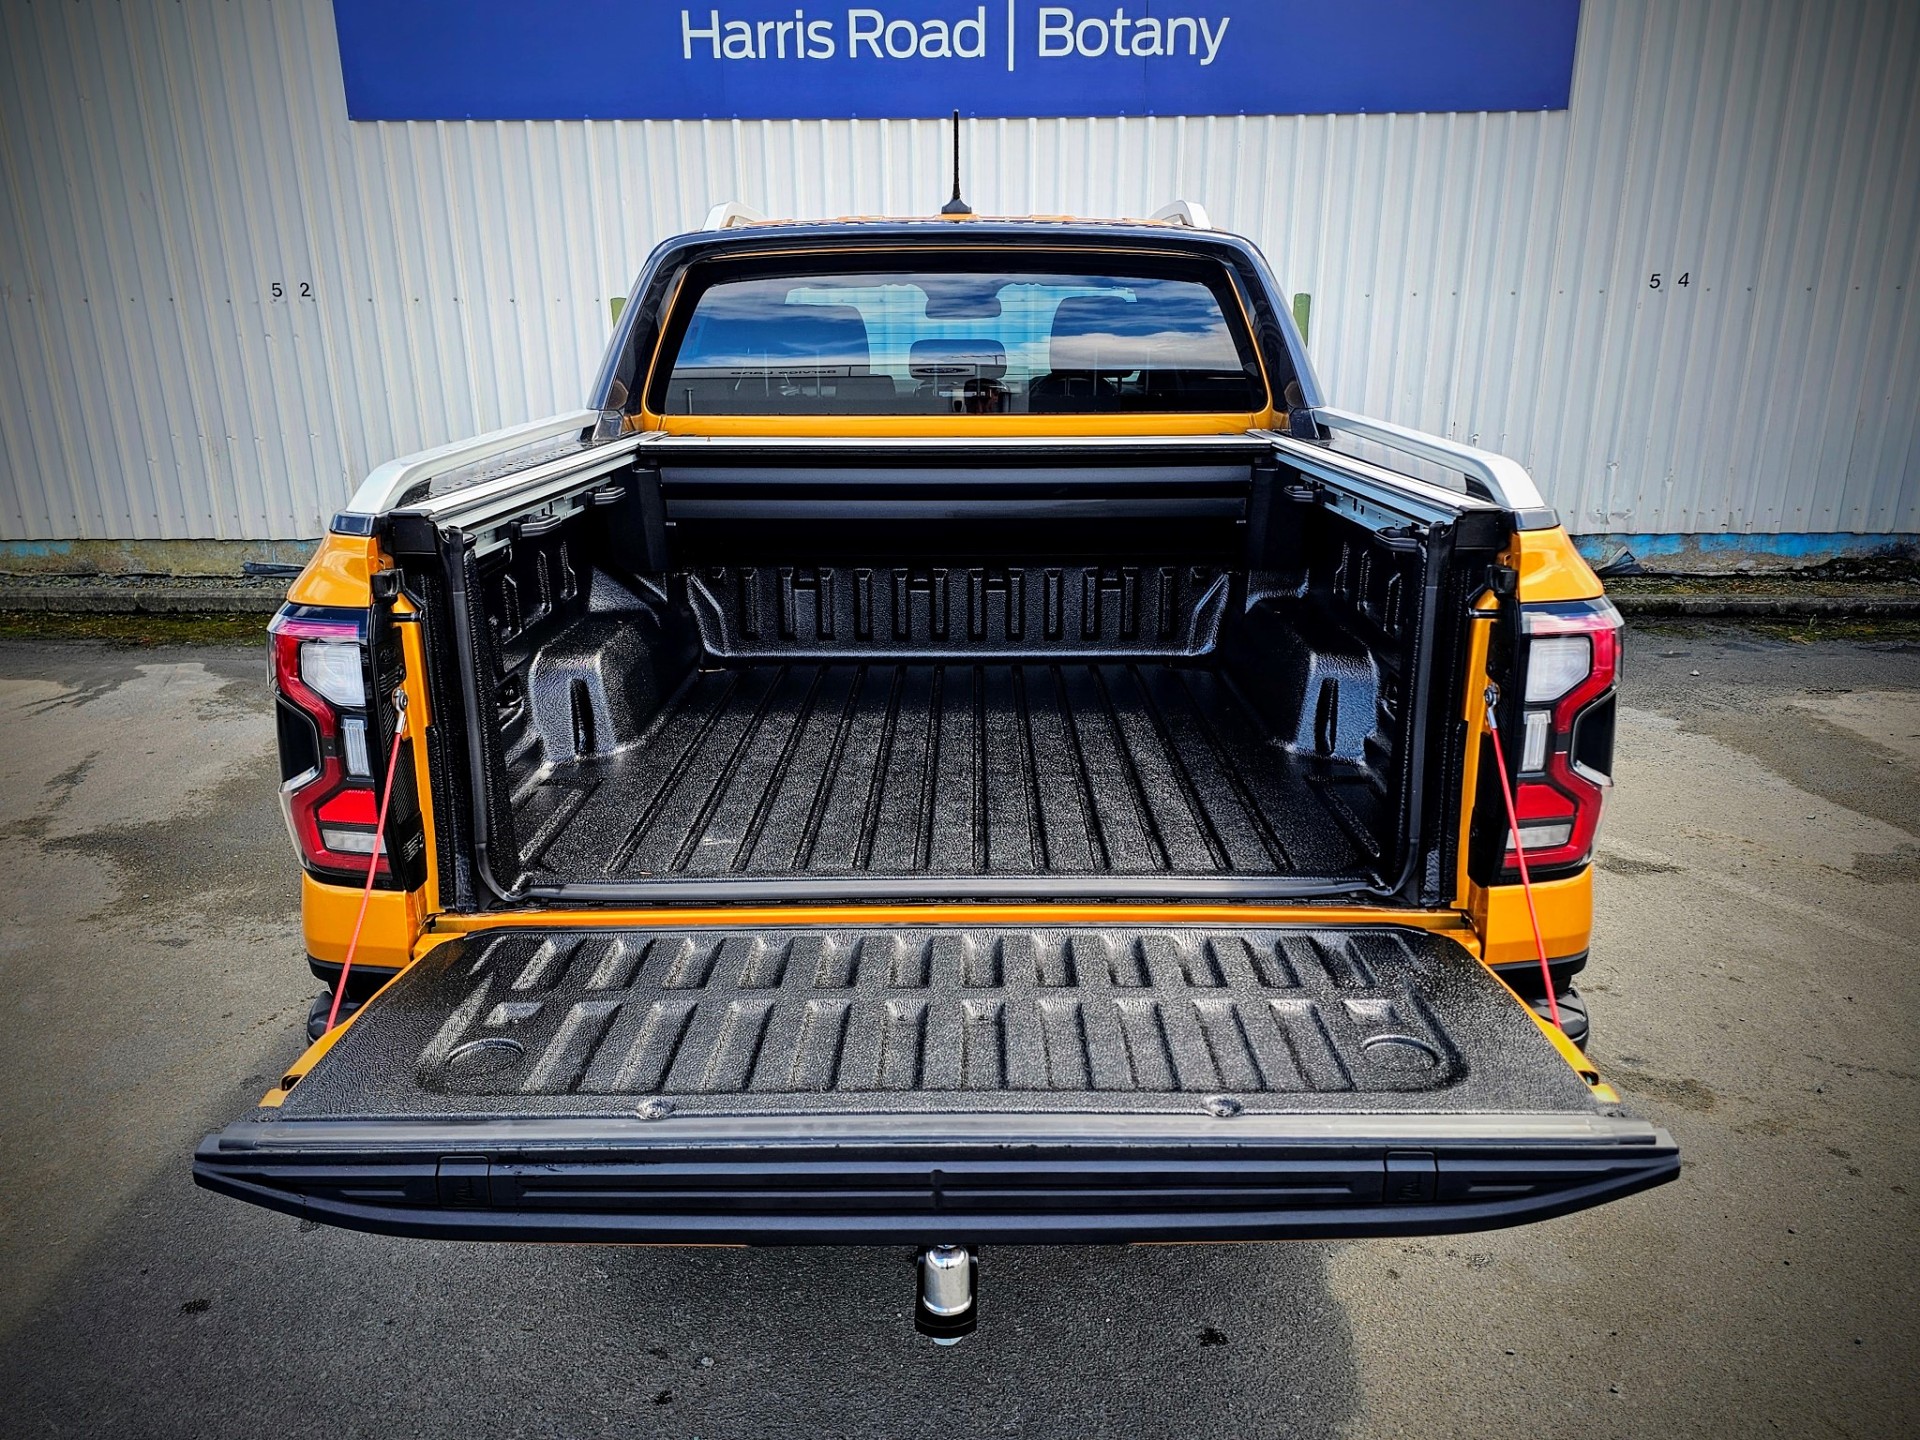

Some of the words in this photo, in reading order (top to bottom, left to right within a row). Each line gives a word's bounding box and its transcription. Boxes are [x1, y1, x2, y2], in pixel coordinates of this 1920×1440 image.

[681, 9, 835, 60] Harris
[848, 5, 986, 59] Road
[1038, 7, 1231, 66] Botany
